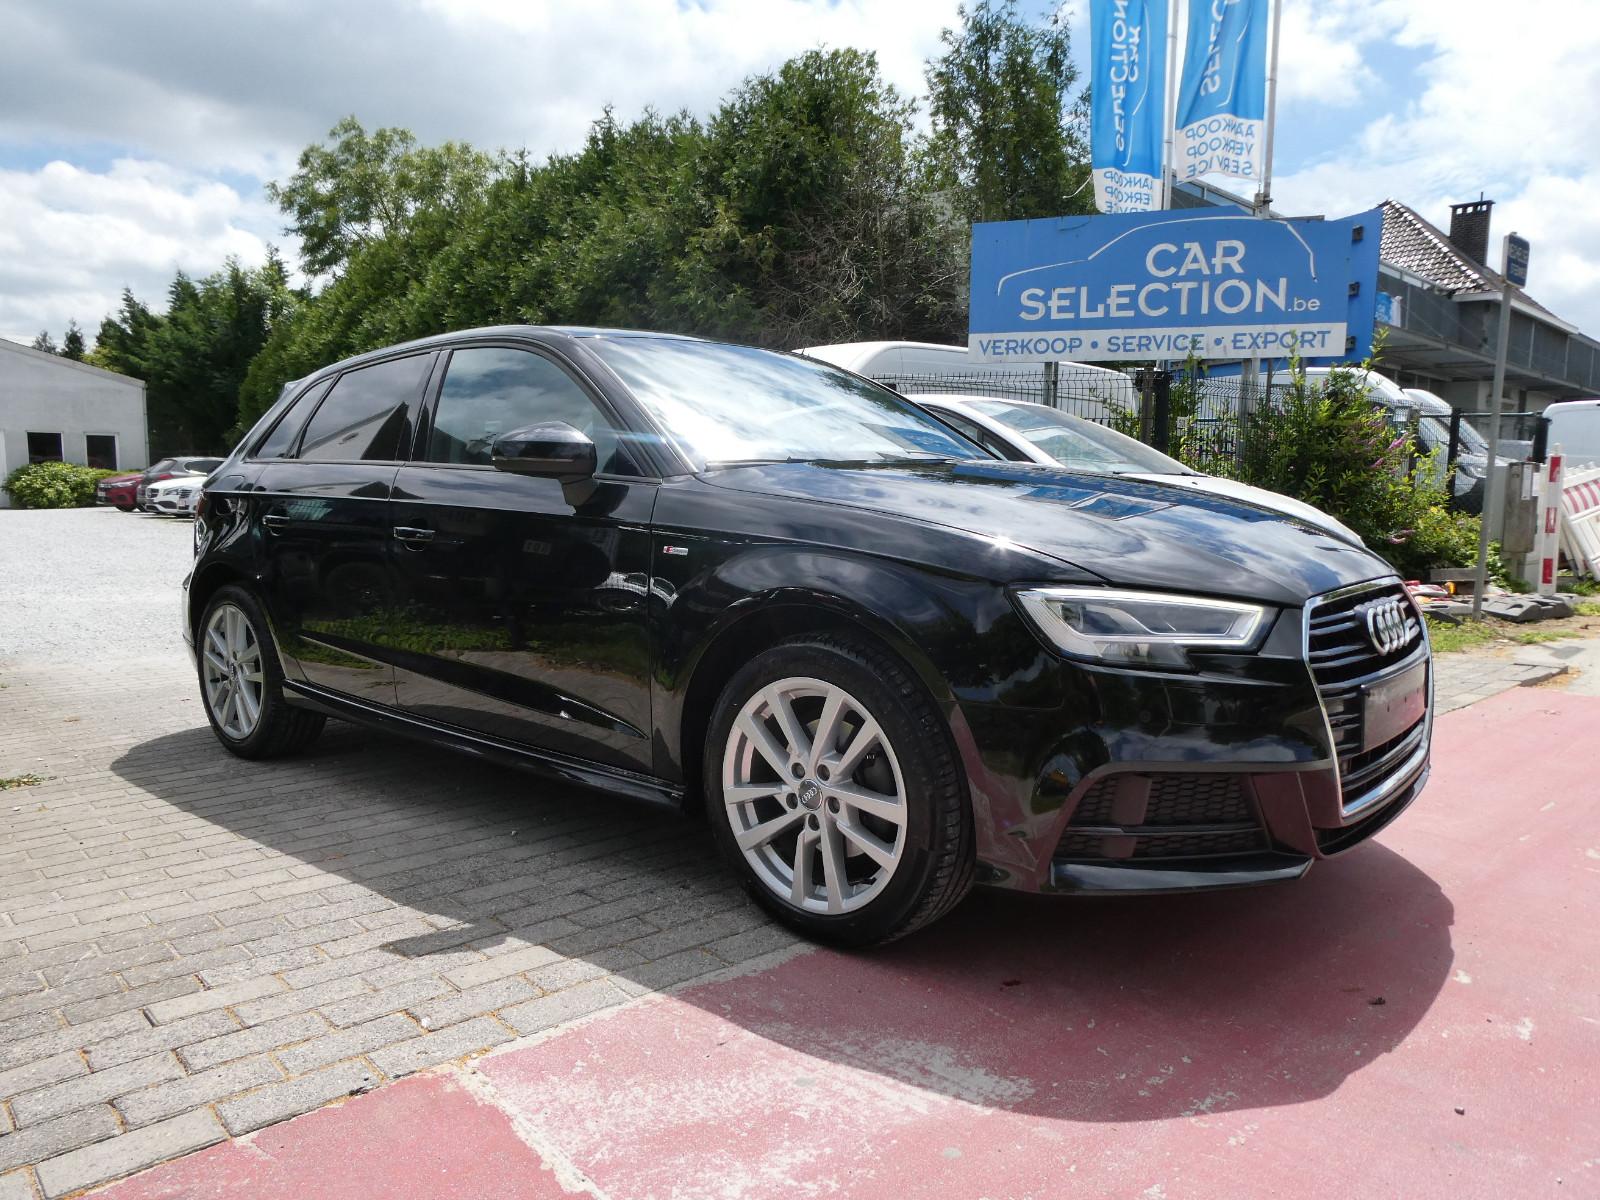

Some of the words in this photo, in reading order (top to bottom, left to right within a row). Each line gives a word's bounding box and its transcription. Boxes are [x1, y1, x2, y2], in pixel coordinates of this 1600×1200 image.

[1145, 239, 1246, 278] CAR
[979, 336, 1082, 356] VERKOOP
[1107, 333, 1204, 353] SERVICE
[1231, 330, 1332, 350] EXPORT
